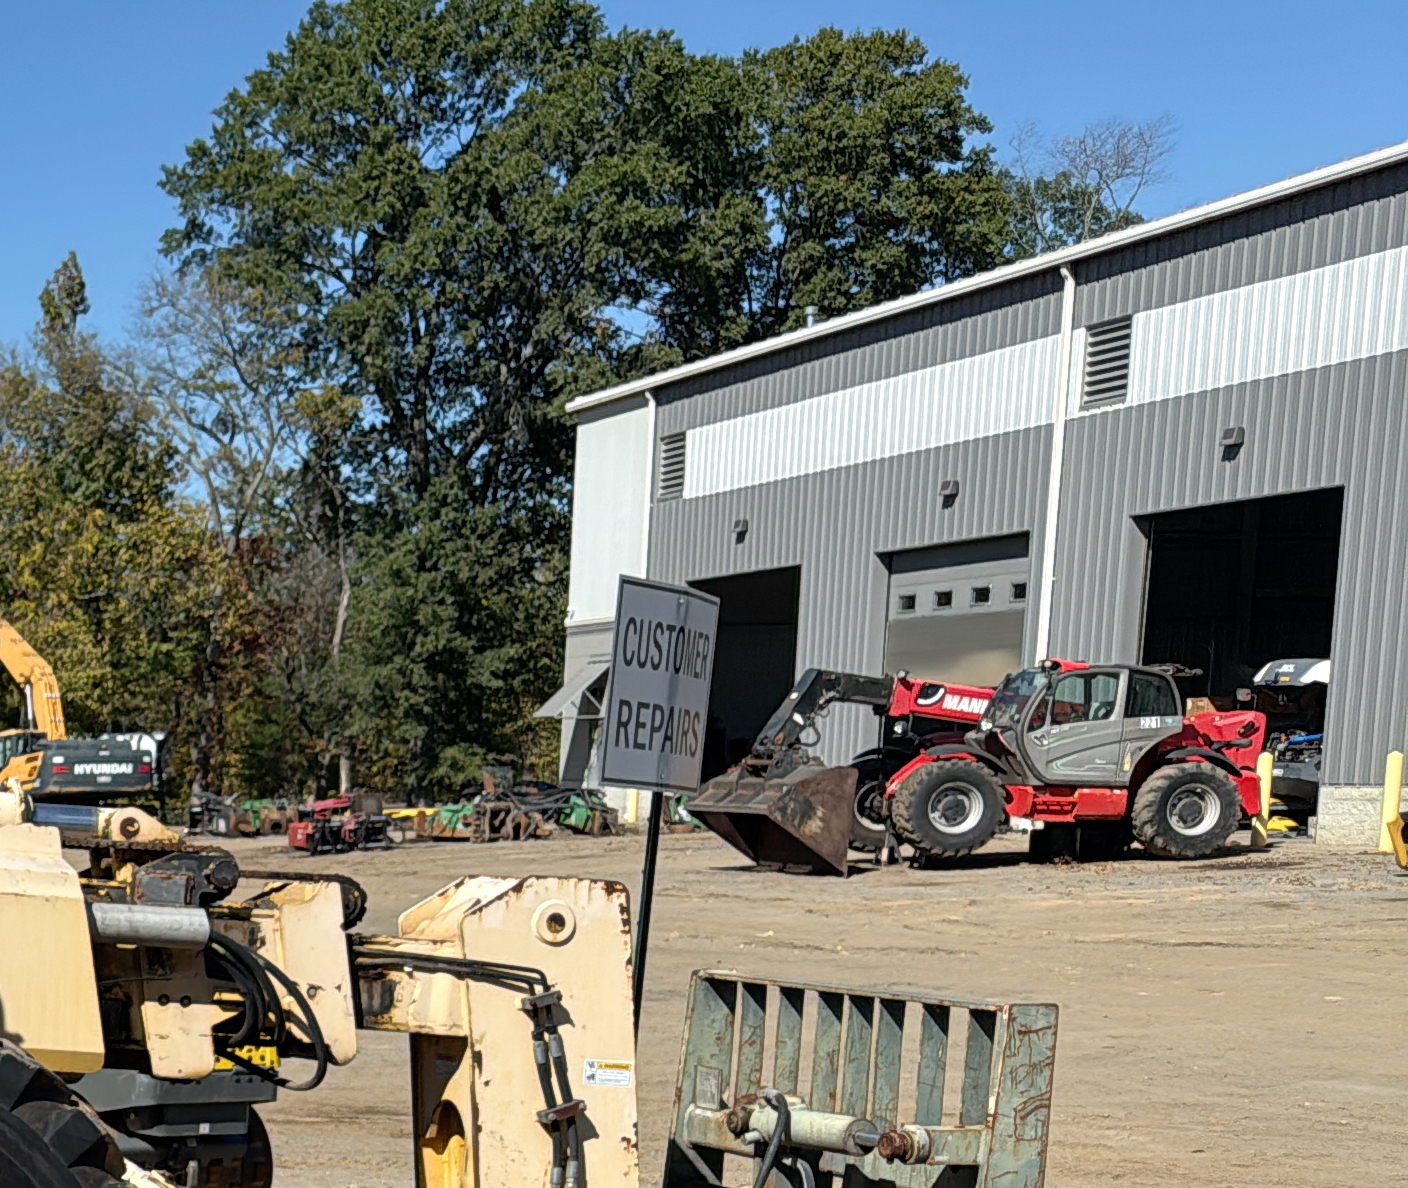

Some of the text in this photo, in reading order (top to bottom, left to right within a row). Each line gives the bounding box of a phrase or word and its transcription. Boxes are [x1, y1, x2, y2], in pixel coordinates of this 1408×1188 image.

[622, 616, 710, 681] CUSTOMER
[614, 698, 700, 759] REPAIRS
[73, 762, 135, 775] HYUNDAI
